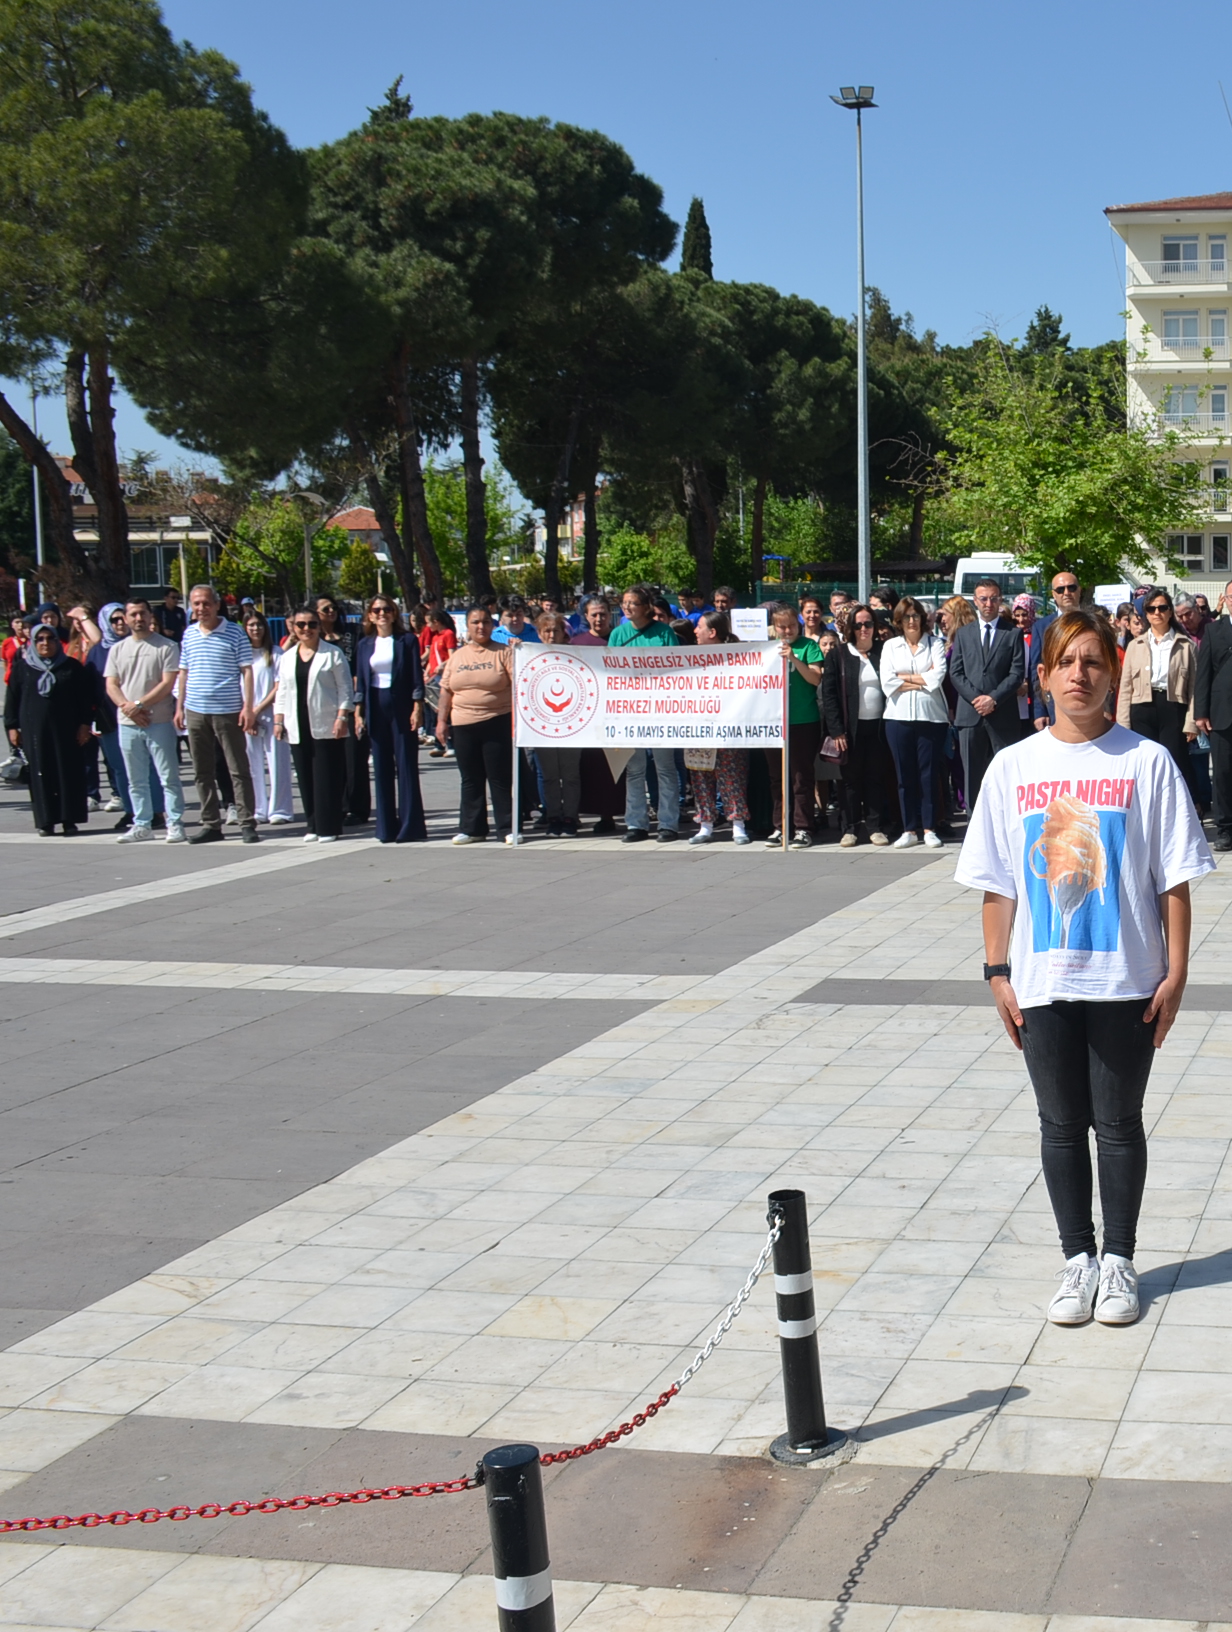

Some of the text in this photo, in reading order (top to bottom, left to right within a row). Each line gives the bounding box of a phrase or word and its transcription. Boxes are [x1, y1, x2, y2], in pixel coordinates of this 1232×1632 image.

[602, 652, 764, 671] KULA ENGELSİZ YAŞAM BAKIM,
[606, 672, 693, 690] REHABİLİTASYON
[696, 676, 710, 690] VE
[712, 671, 734, 690] AİLE
[606, 695, 720, 714] MERKEZİ MÜDÜRLÜĞÜ
[605, 726, 616, 738] 10
[624, 726, 634, 738] 16
[637, 726, 664, 738] MAYIS
[667, 722, 714, 738] ENGELLERİ
[716, 726, 742, 742] AŞMA
[745, 725, 782, 738] HAFTASI
[1016, 778, 1135, 815] PASTA NIGHT
